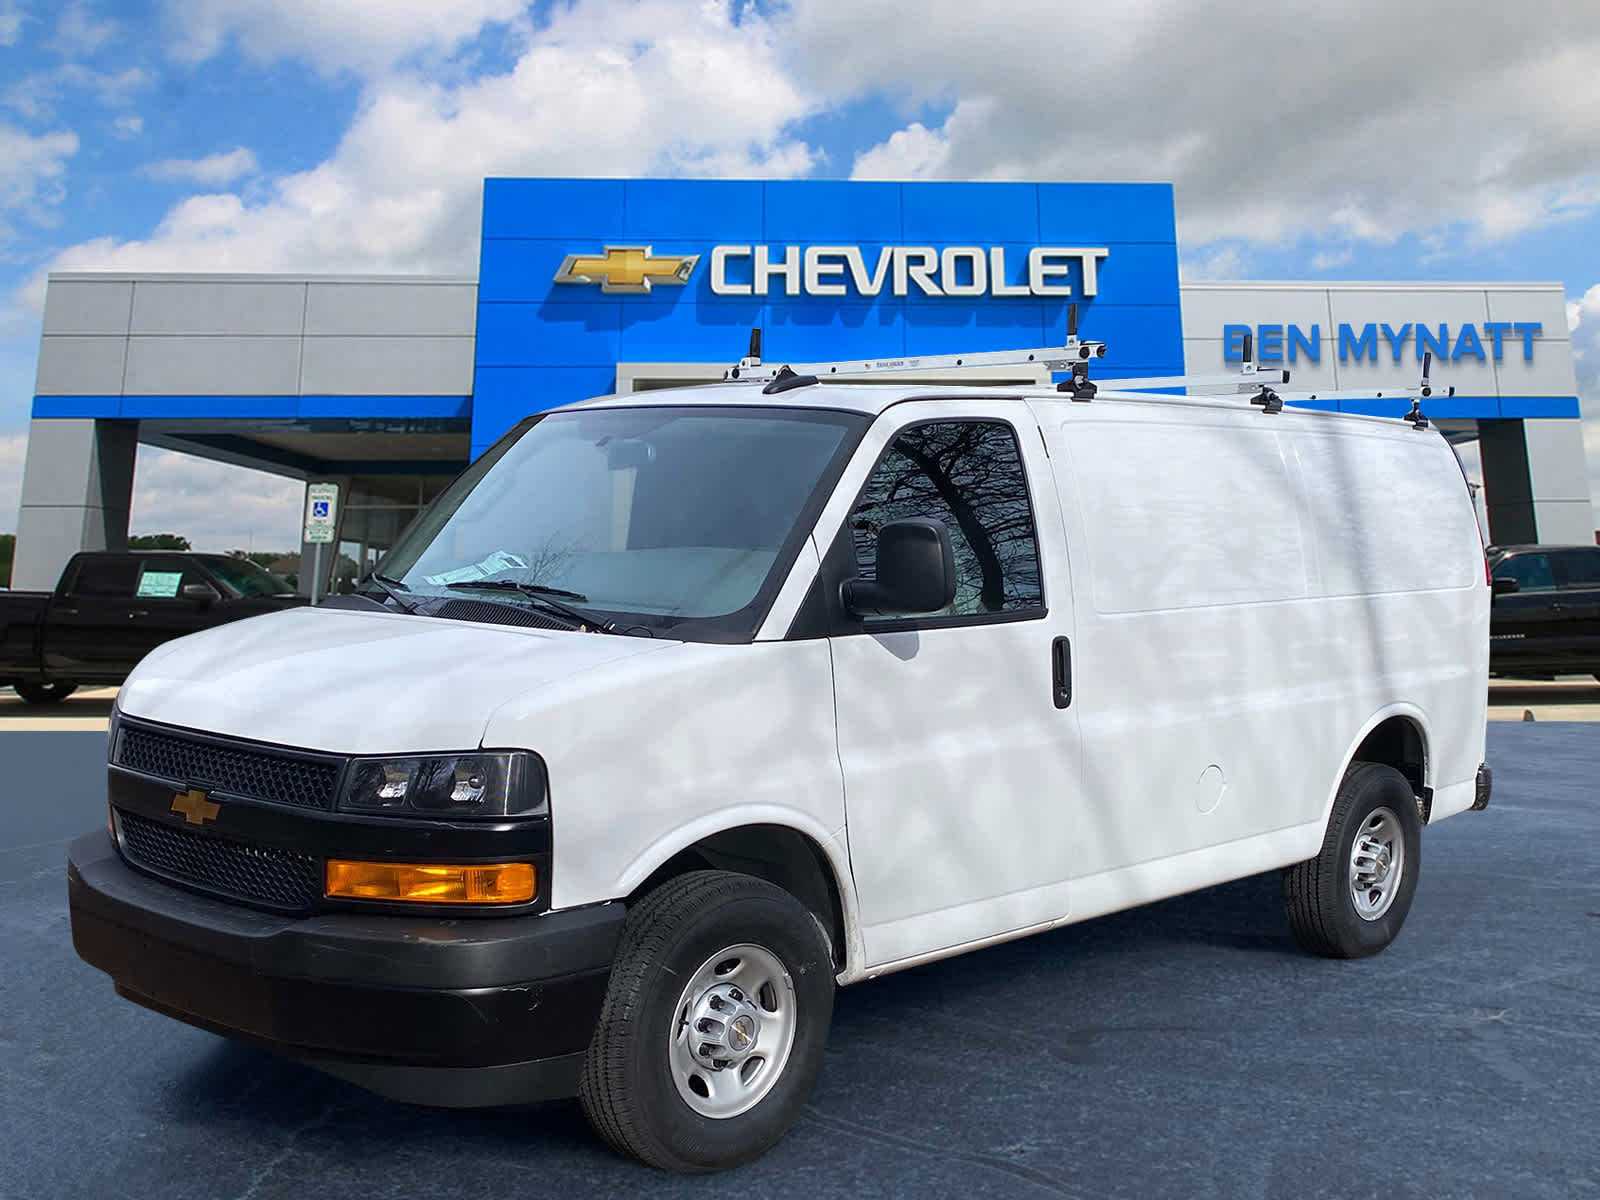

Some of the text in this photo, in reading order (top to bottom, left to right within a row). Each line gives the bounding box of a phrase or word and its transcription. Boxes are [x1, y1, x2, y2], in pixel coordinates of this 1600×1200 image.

[710, 245, 1109, 296] CHEVROLET
[1223, 322, 1543, 361] BEN MYNATT
